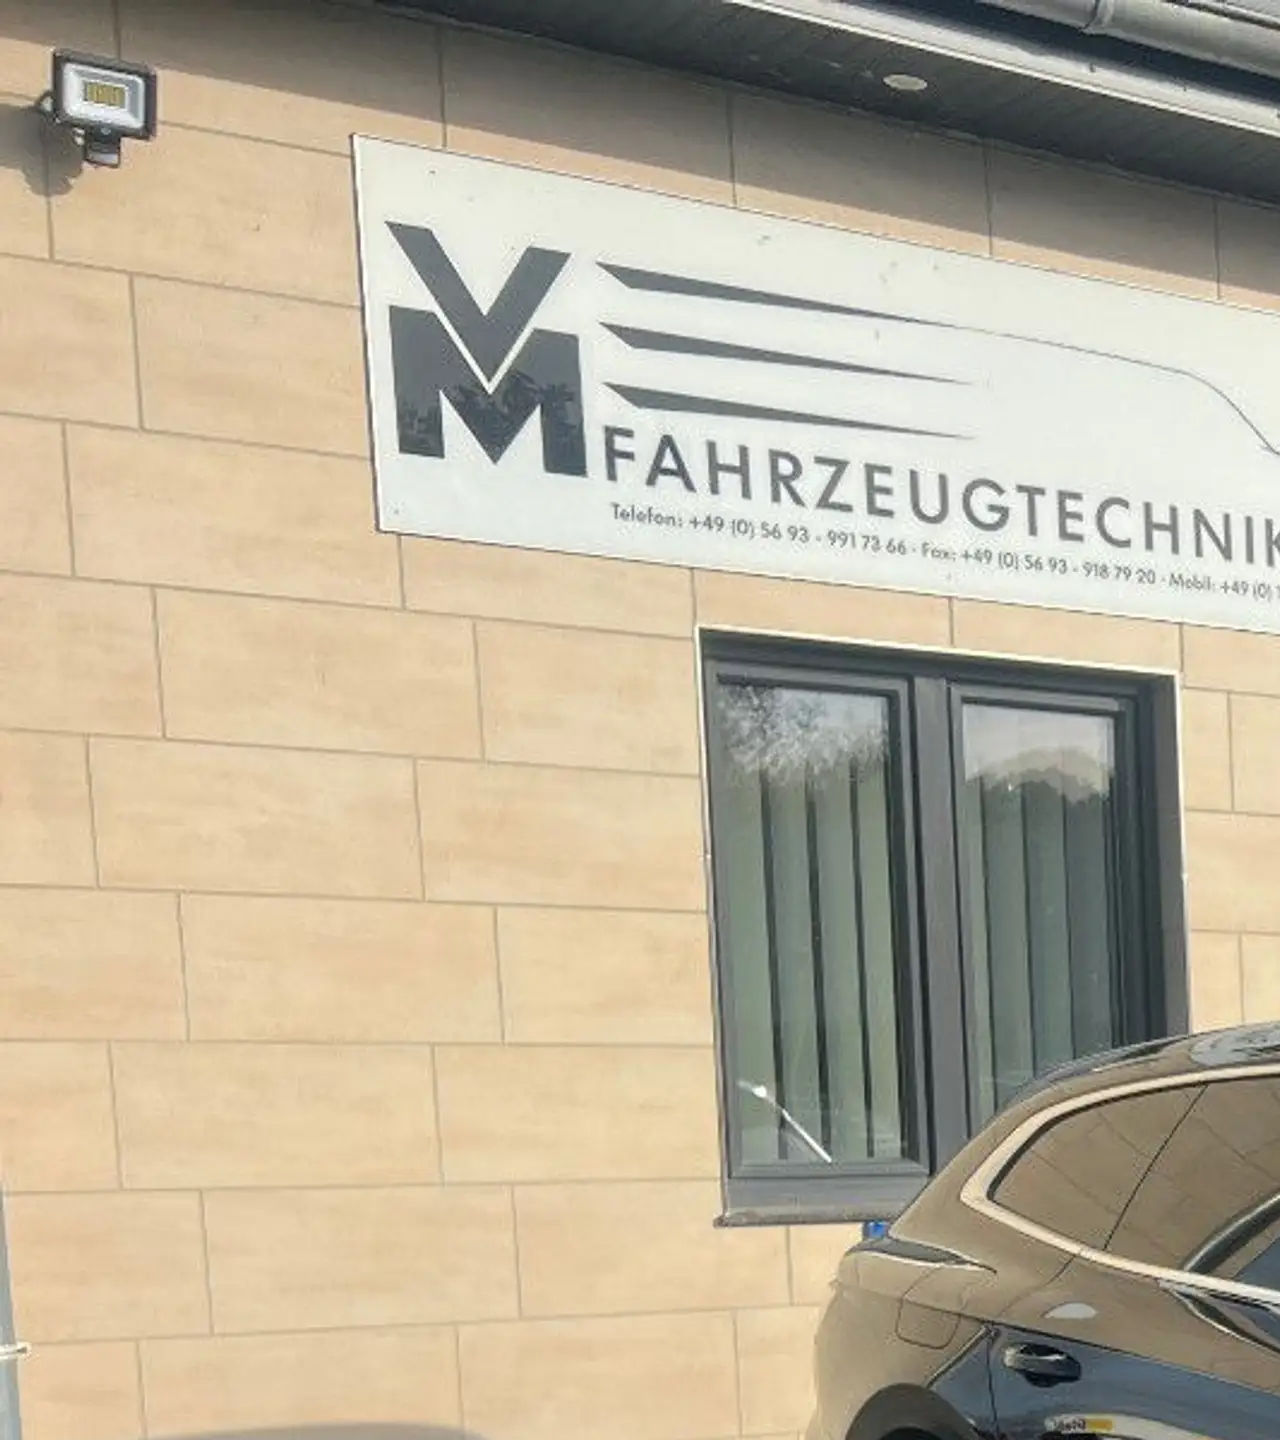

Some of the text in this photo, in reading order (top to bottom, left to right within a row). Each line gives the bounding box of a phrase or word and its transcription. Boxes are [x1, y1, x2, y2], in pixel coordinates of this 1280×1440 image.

[610, 502, 683, 528] Telefon:
[689, 515, 724, 532] +49
[731, 518, 755, 540] (0)
[760, 521, 782, 540] 56
[787, 525, 810, 543] 93
[827, 529, 856, 549] 991
[886, 538, 908, 555] 66
[921, 542, 956, 562] Fax:
[961, 549, 993, 565] +49
[998, 551, 1020, 570] (0)
[1023, 554, 1043, 571] 56
[1048, 557, 1068, 575] 93
[1082, 561, 1110, 579] 918
[1114, 565, 1132, 582] 79
[1135, 568, 1156, 585] 20
[1168, 572, 1215, 592] Mobil:
[1220, 579, 1249, 596] +49
